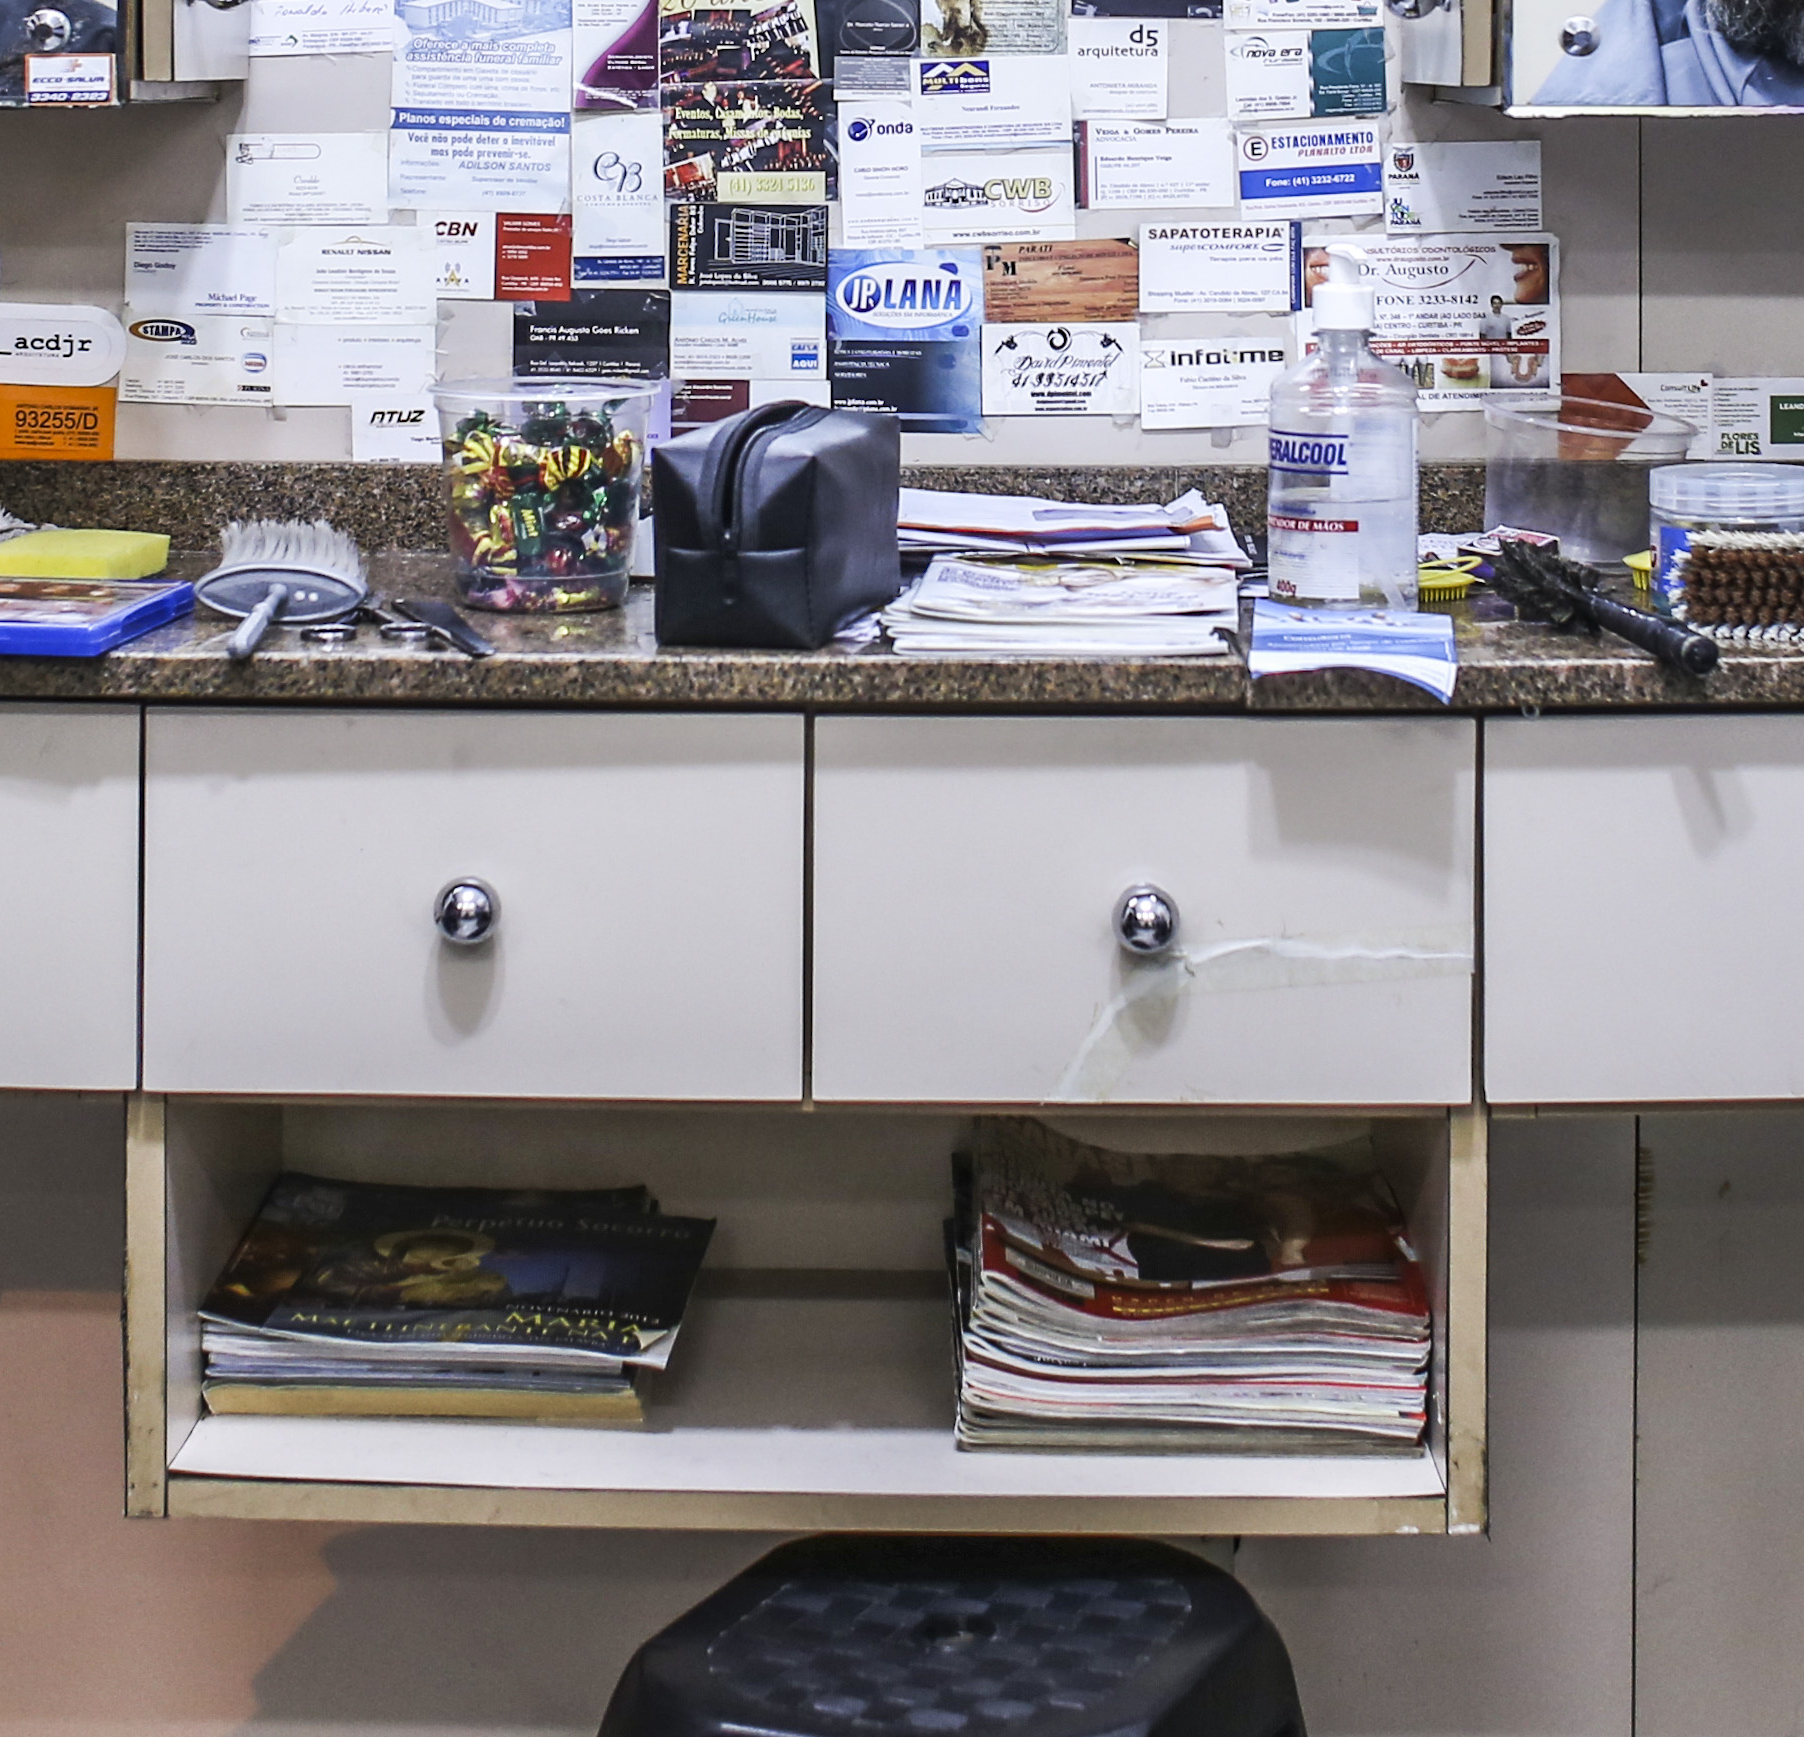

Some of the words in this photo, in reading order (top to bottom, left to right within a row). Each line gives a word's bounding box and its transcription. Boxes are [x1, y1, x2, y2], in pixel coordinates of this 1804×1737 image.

[1130, 24, 1159, 47] d5
[413, 38, 462, 51] Oferece
[517, 52, 563, 65] familiar
[1077, 45, 1159, 59] arquitetura
[1246, 48, 1276, 58] nova
[1280, 48, 1303, 57] era
[675, 106, 713, 121] Eventos,
[399, 113, 436, 124] Planos
[439, 115, 490, 127] especiais
[492, 115, 507, 125] de
[508, 117, 565, 130] cremação!
[876, 121, 913, 135] onda
[1165, 127, 1199, 135] PEREIRA
[408, 132, 429, 143] Você
[431, 133, 448, 144] não
[451, 134, 473, 146] pode
[476, 134, 499, 145] deter
[1271, 131, 1373, 150] ESTACIONAMENTO
[452, 148, 474, 159] pode
[1251, 141, 1262, 156] E
[1297, 148, 1346, 158] PLANALTO
[1349, 145, 1373, 155] LTDA
[459, 160, 506, 170] ADILSON
[508, 161, 551, 171] SANTOS
[729, 178, 751, 195] (41)
[756, 178, 783, 191] 3324
[1265, 177, 1291, 187] Fone:
[1292, 176, 1310, 187] (41)
[984, 177, 1053, 200] CWB
[577, 194, 611, 202] COSTA
[616, 194, 659, 202] BLANCA
[990, 199, 1051, 208] SORRISO
[435, 221, 478, 236] CBN
[1148, 227, 1282, 240] SAPATOTERAPIA
[1018, 245, 1053, 254] PARATI
[1358, 264, 1380, 276] Dr.
[1385, 263, 1449, 281] Augusto
[208, 293, 237, 302] Michael
[240, 294, 257, 303] Page
[1376, 295, 1414, 306] FONE
[1418, 294, 1479, 305] 3233-8142
[718, 312, 778, 324] GreenHouse
[142, 325, 184, 338] STAMPA
[530, 325, 557, 334] Francis
[558, 326, 590, 336] Augusto
[792, 358, 818, 368] AQUI
[15, 411, 99, 431] 93255/D
[1721, 432, 1759, 442] FLORES
[1735, 440, 1761, 455] LIS
[1313, 519, 1344, 531] MÃOS
[1277, 579, 1297, 594] 400g
